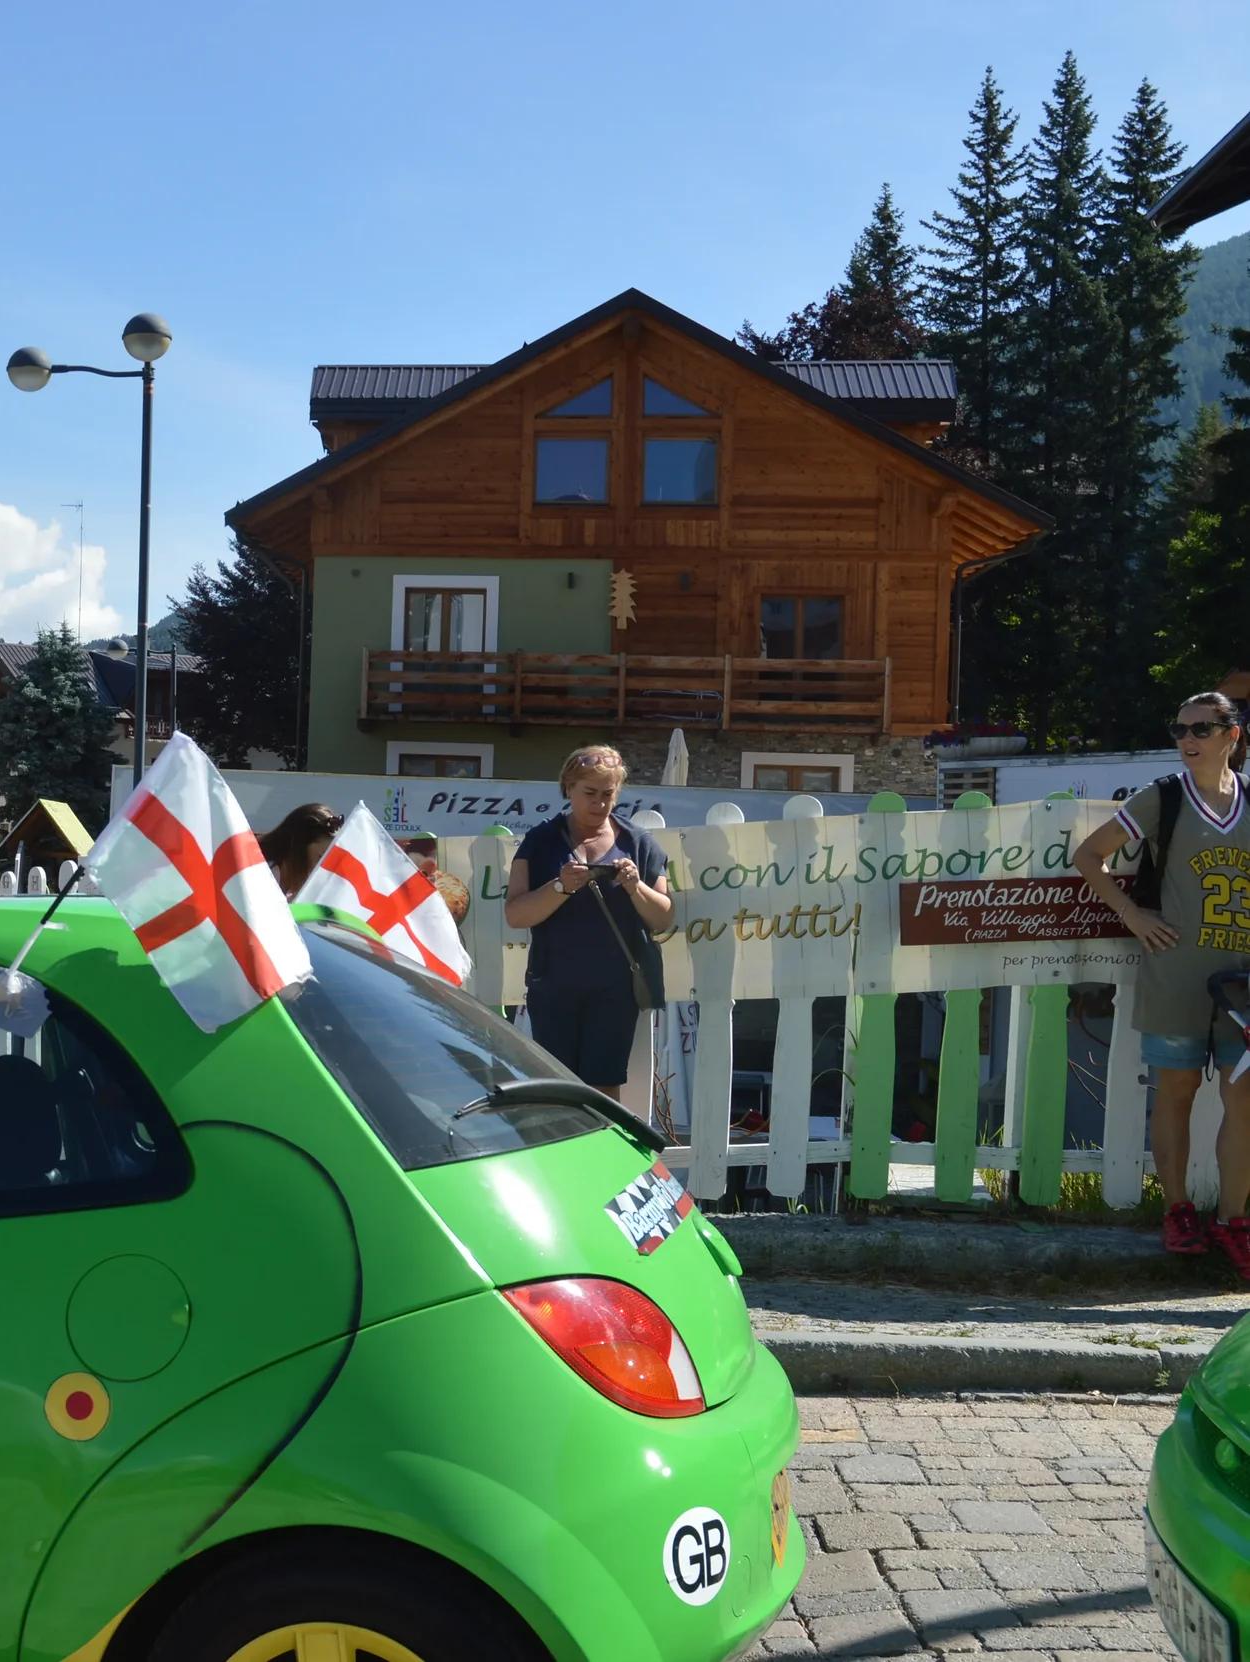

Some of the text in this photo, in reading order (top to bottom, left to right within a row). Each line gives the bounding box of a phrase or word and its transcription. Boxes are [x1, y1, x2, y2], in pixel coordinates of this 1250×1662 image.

[698, 860, 795, 891] con
[804, 845, 848, 885] il
[853, 844, 1035, 884] Sapore
[1188, 845, 1250, 876] FRENC
[943, 911, 969, 927] Via
[980, 907, 1056, 934] Villaggio
[1201, 873, 1250, 930] 23
[732, 902, 863, 941] tutti!
[1002, 955, 1026, 969] per
[1031, 951, 1124, 970] prenotazioni
[672, 1519, 727, 1594] GB
